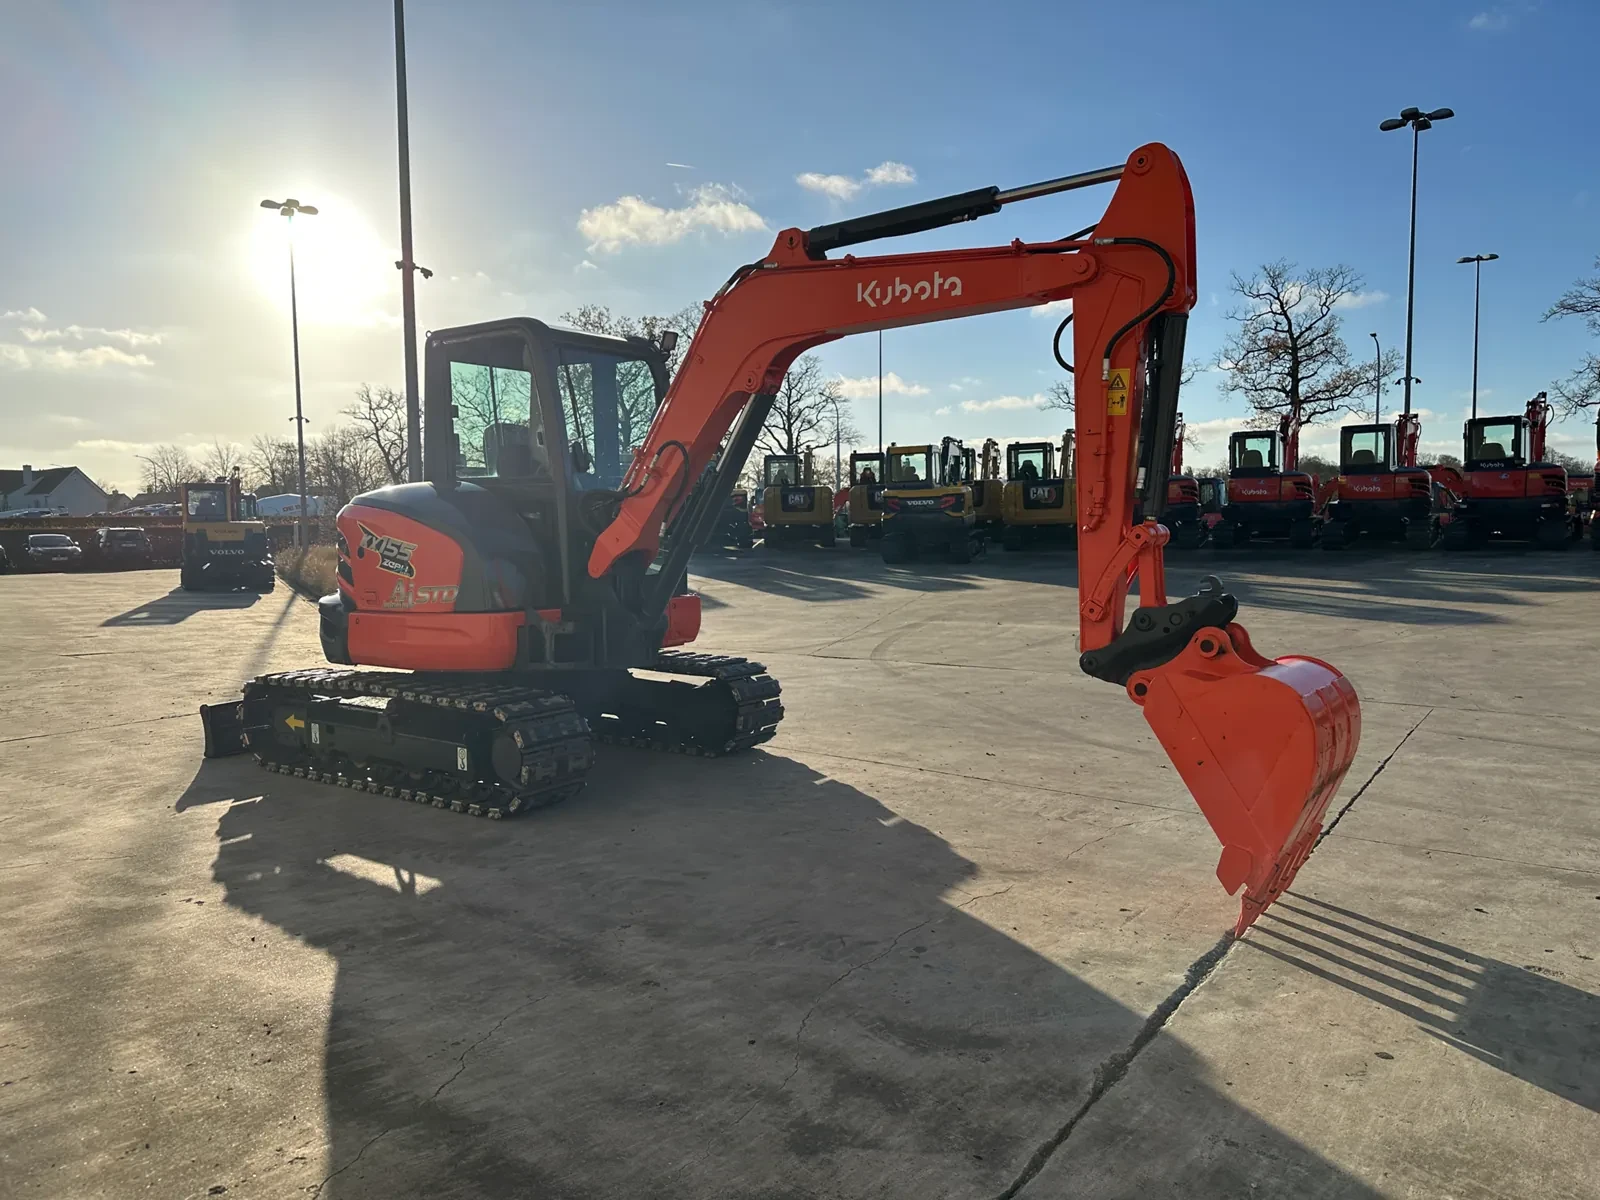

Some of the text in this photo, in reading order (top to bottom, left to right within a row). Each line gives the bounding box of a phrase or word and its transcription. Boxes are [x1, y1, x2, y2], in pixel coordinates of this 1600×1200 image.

[856, 270, 962, 308] Kubota
[1030, 487, 1050, 500] CAT
[1353, 484, 1381, 492] Kubota
[788, 494, 805, 505] CAT
